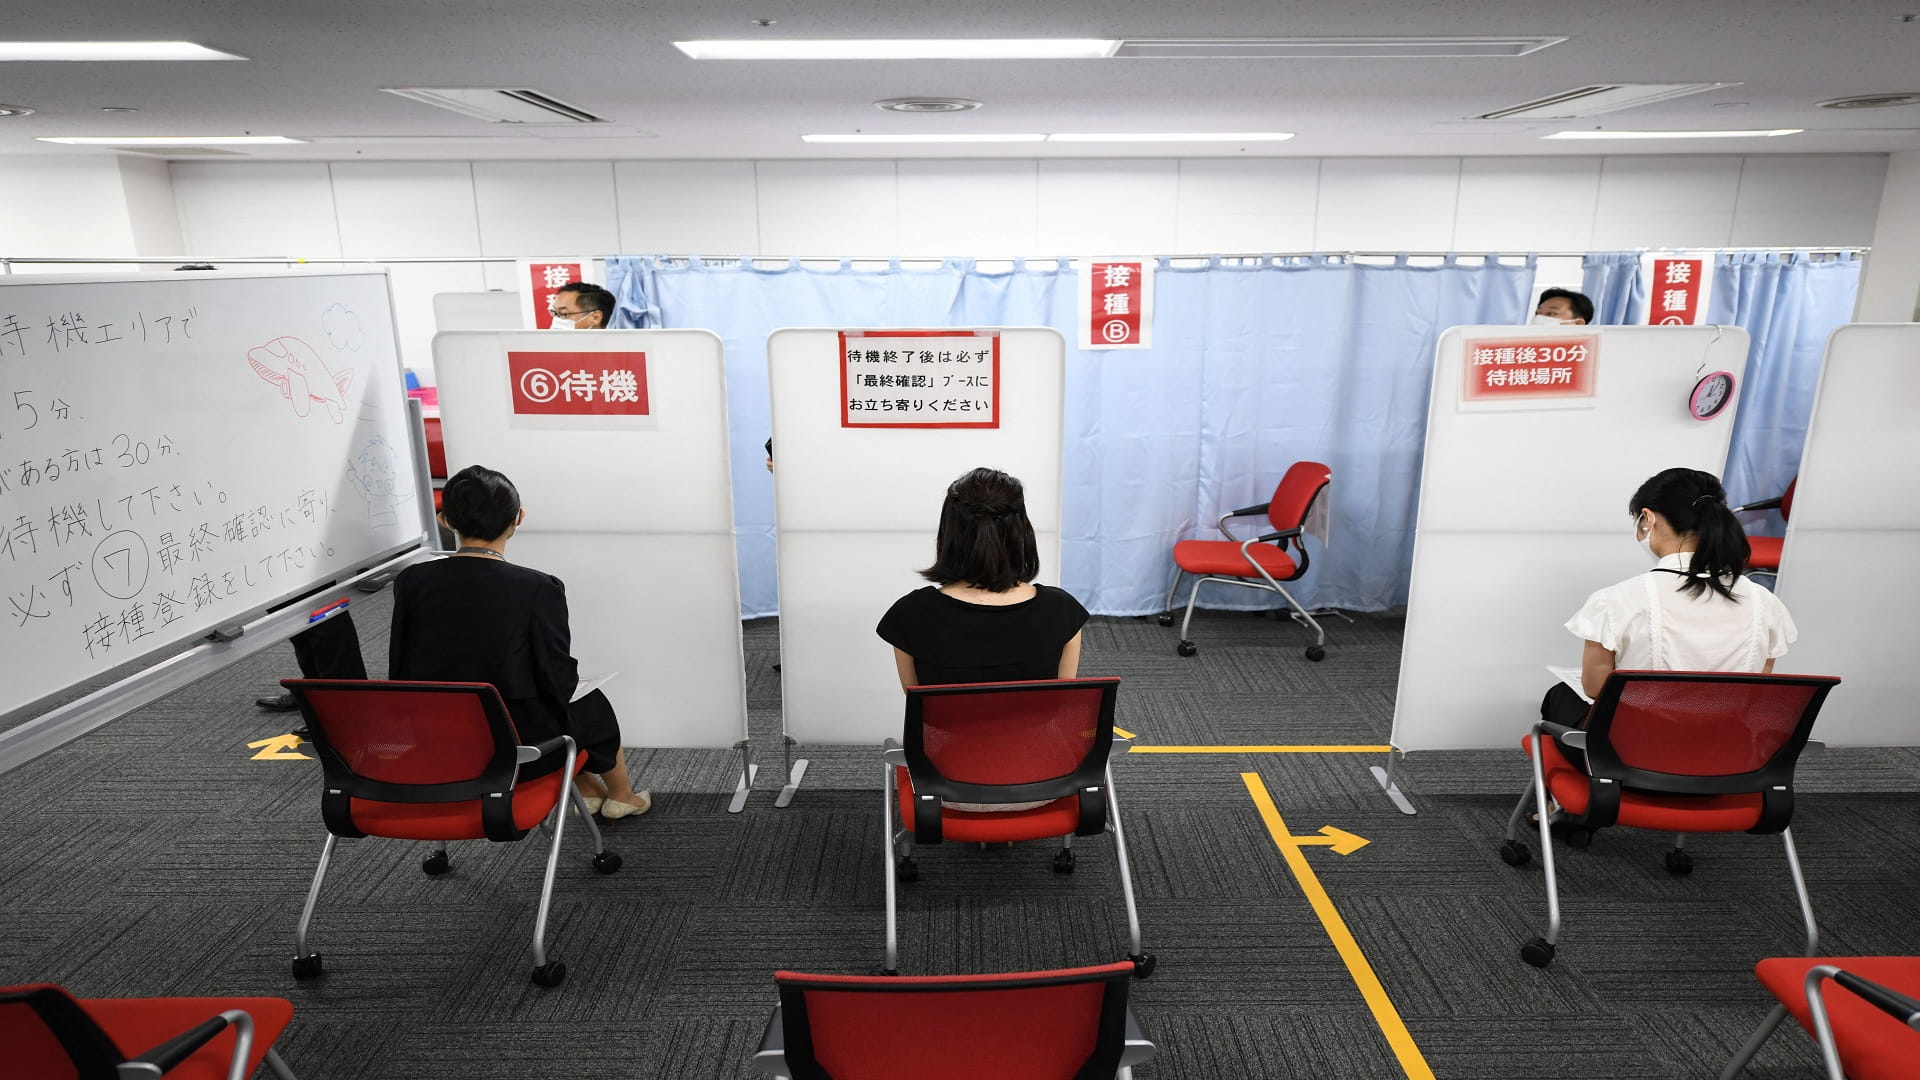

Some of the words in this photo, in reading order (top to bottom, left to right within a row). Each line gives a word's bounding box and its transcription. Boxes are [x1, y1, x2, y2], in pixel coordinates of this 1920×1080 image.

[847, 350, 990, 364] 待機終了後は必ず
[1473, 345, 1589, 365] 接種後30分
[520, 368, 639, 403] ⑥待機
[1486, 367, 1573, 387] 待機場所
[848, 398, 989, 412] お立ち寄りください
[0, 481, 227, 561] 待機して下さい。
[83, 541, 335, 660] 接種登録をして下さい。
